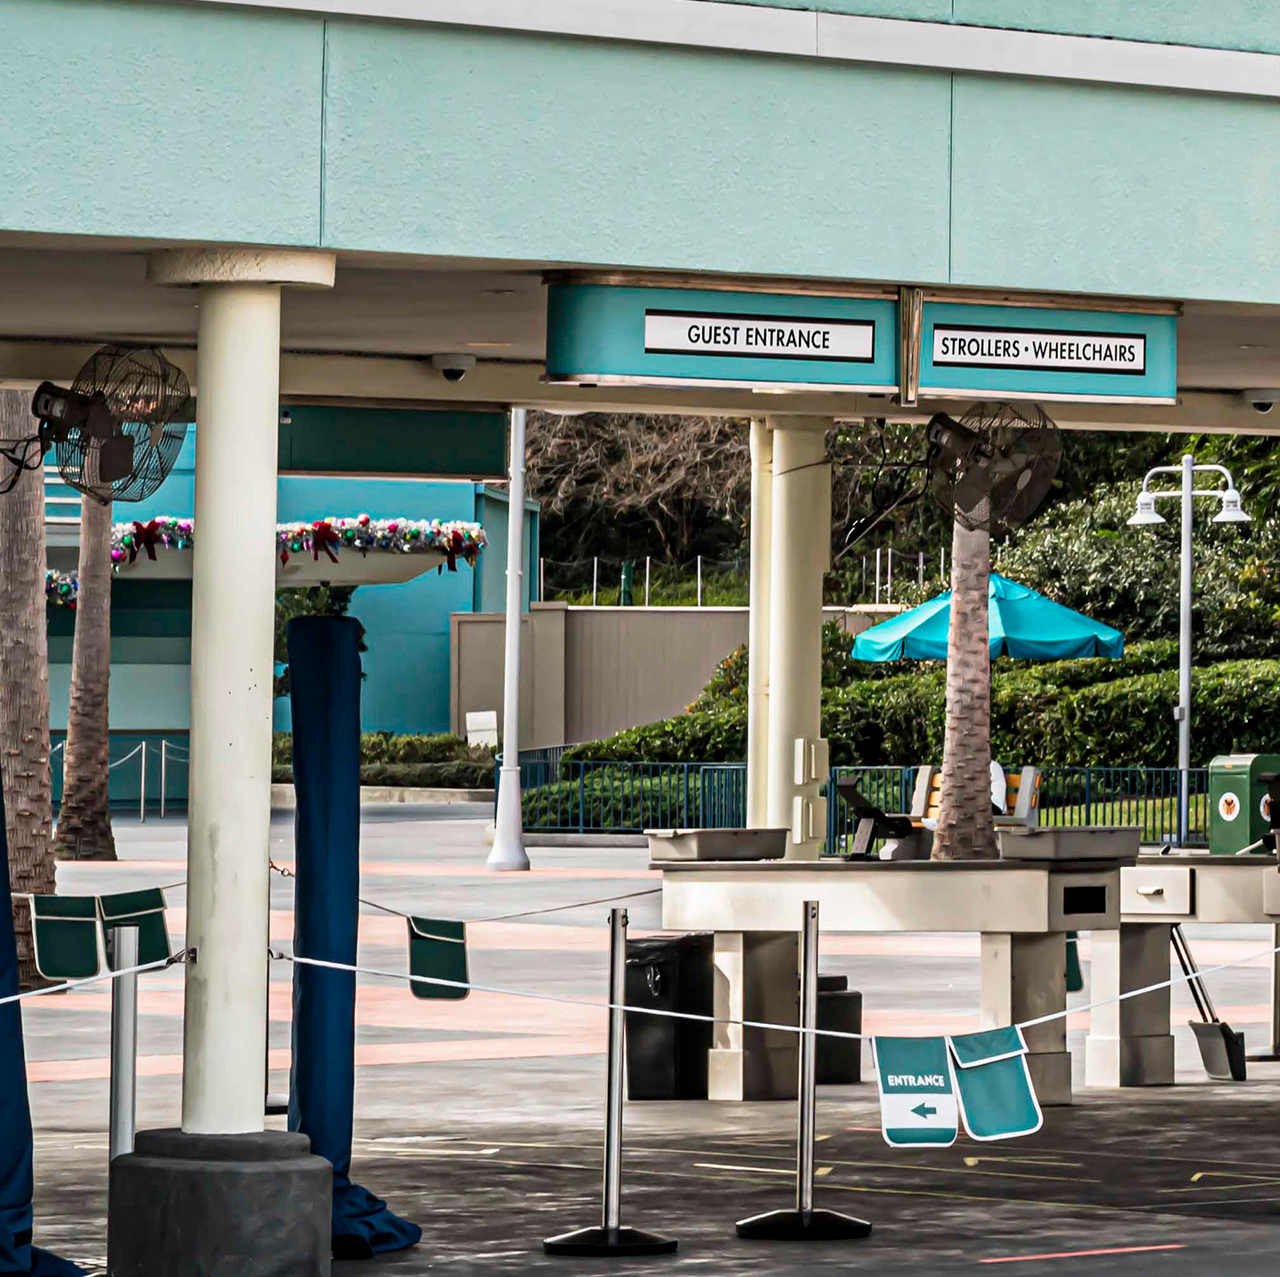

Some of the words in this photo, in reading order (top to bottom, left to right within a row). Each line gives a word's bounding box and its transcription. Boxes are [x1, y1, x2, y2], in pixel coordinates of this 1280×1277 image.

[687, 324, 741, 346] GUEST
[745, 327, 830, 349] ENTRANCE
[941, 336, 1020, 358] STROLLERS
[1032, 340, 1136, 363] WHEELCHAIRS
[887, 1074, 945, 1087] ENTRANCE
